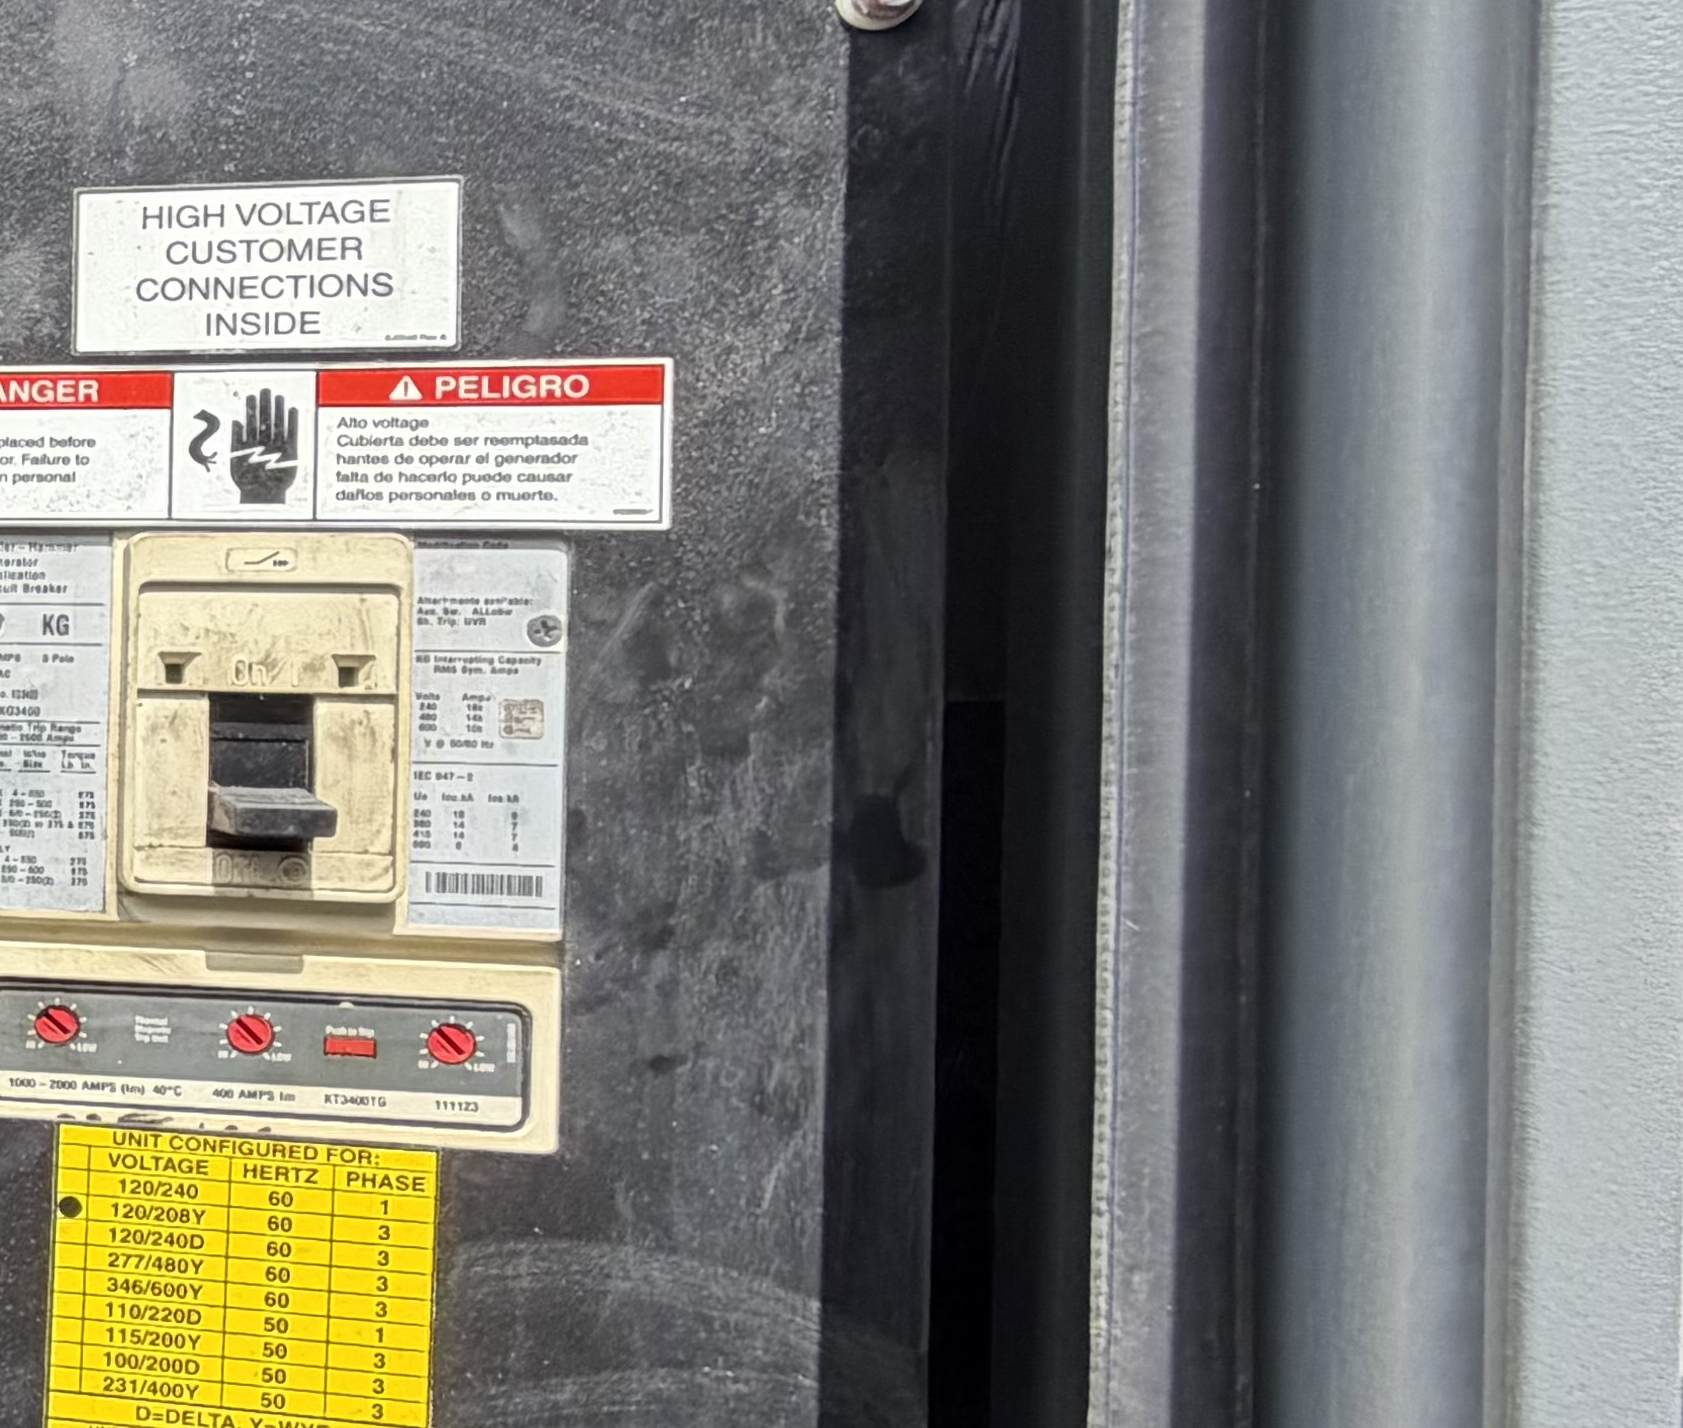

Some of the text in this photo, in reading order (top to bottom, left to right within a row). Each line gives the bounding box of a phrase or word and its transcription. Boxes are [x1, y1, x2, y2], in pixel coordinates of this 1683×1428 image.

[142, 199, 391, 229] HIGH VOLTAGE
[166, 237, 363, 265] CUSTOMER
[135, 273, 394, 302] CONNECTIONS
[206, 312, 321, 336] INSIDE
[435, 374, 590, 399] PELIGRO
[337, 417, 429, 432] Alto voltage
[49, 436, 96, 448] before
[337, 435, 404, 446] Cubierta
[408, 434, 448, 446] debe
[454, 436, 479, 446] ser
[21, 453, 71, 466] Failure
[75, 454, 89, 466] to
[336, 451, 578, 468] hantes de operar el generador
[12, 471, 76, 485] personal
[335, 470, 572, 485] falta de hacerlo puede causar
[335, 488, 558, 503] daños personales o muerte.
[23, 584, 68, 594] Breaker
[42, 613, 69, 636] KG
[9, 1078, 36, 1088] 1000
[50, 1080, 77, 1090] 2000
[82, 1081, 116, 1092] AMPS
[112, 1132, 380, 1166] UNIT CONFIGURED FOR:
[108, 1153, 426, 1192] VOLTAGE HERTZ PHASE
[119, 1179, 389, 1215] 120/240 60 1
[111, 1203, 391, 1240] 120/208Y 60 3
[109, 1228, 390, 1266] 120/240D 60 3
[108, 1253, 389, 1292] 277/480Y 60 3
[107, 1278, 388, 1317] 346/600Y 60 3
[106, 1302, 384, 1342] 110/220D 50 1
[106, 1327, 386, 1368] 115/200Y 50 3
[104, 1352, 384, 1394] 100/200D 50 3
[103, 1377, 384, 1419] 231/400Y 50 3
